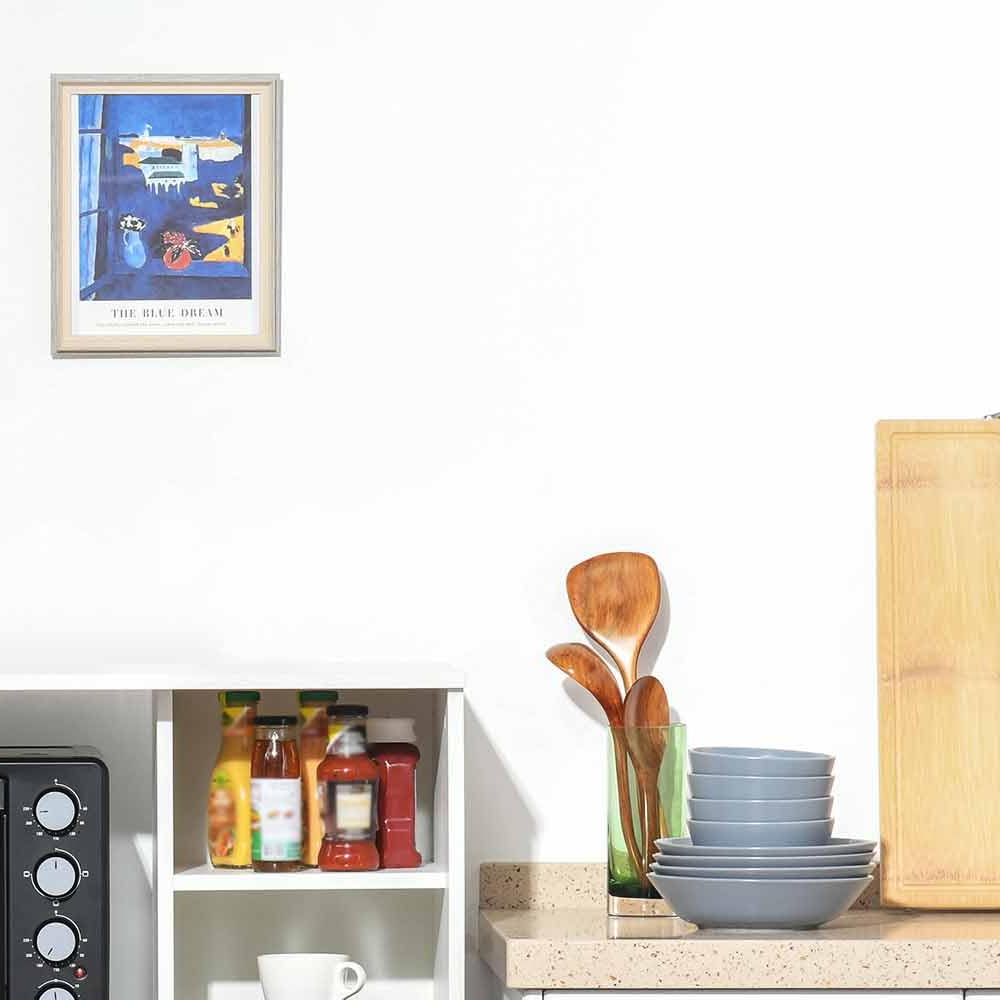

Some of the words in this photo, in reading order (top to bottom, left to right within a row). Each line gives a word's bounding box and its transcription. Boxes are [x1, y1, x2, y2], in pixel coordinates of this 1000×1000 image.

[111, 308, 137, 318] THE
[143, 308, 175, 318] BLUE
[181, 308, 224, 318] DREAM
